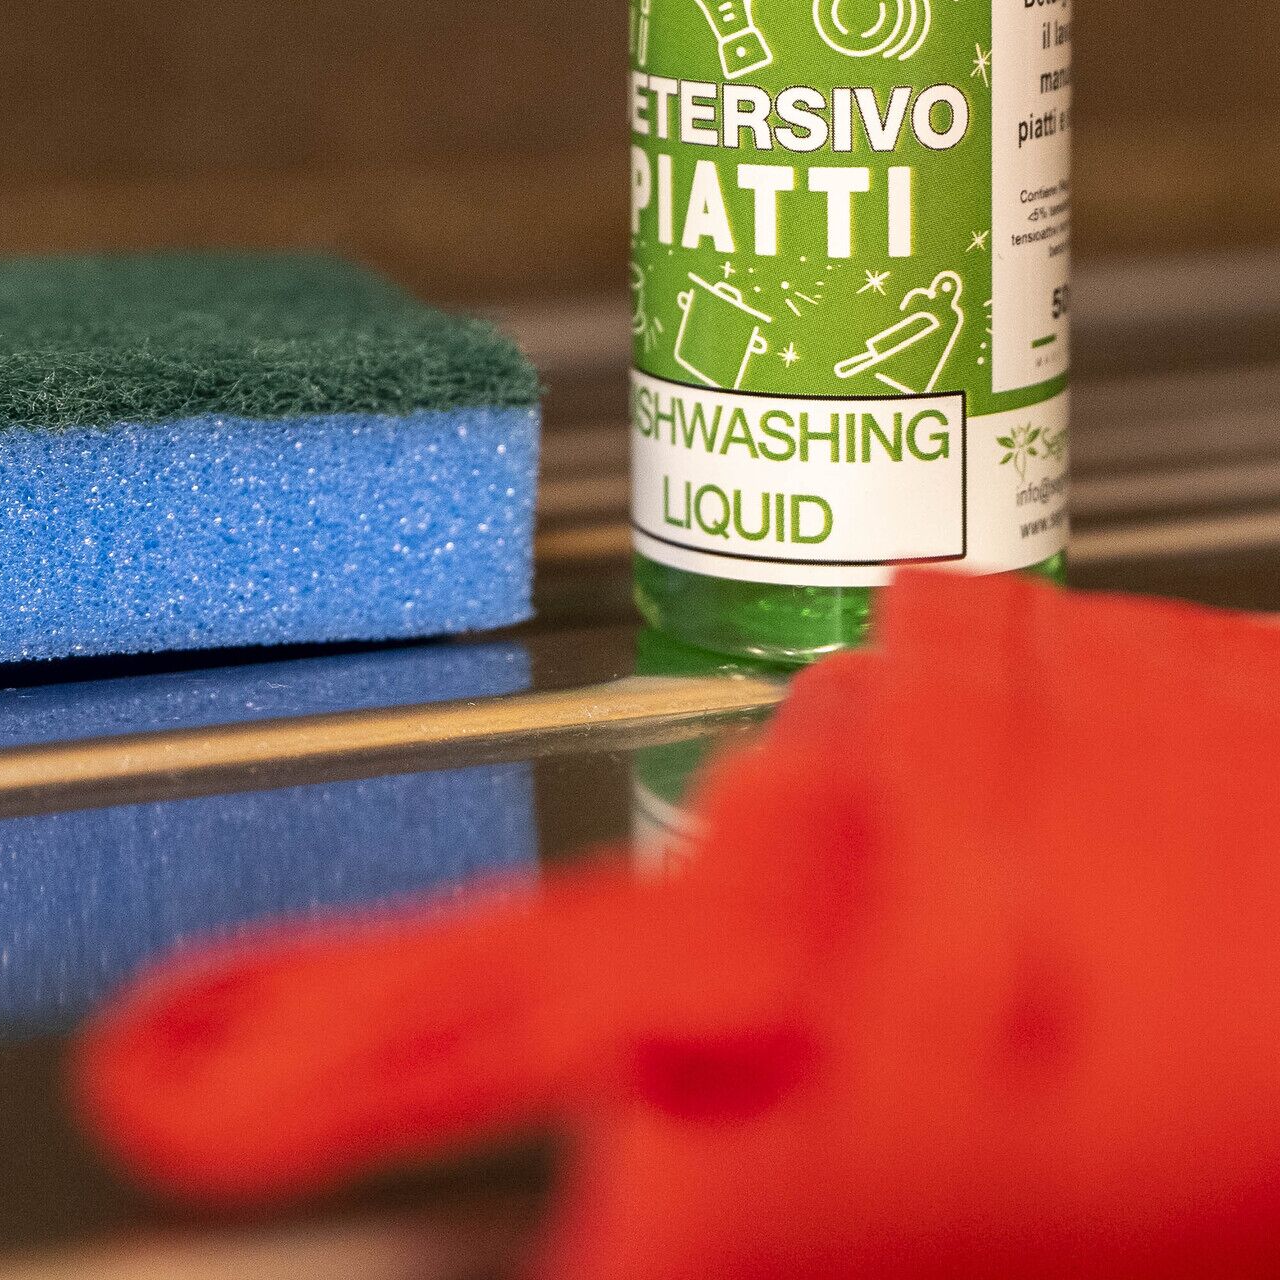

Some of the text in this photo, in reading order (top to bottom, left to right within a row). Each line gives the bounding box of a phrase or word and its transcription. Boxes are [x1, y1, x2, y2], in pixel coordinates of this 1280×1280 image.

[1042, 22, 1051, 50] il
[630, 70, 970, 153] ETERSIVO
[1018, 109, 1056, 149] piatti
[631, 144, 913, 258] PIATTI
[663, 475, 834, 544] LIQUID
